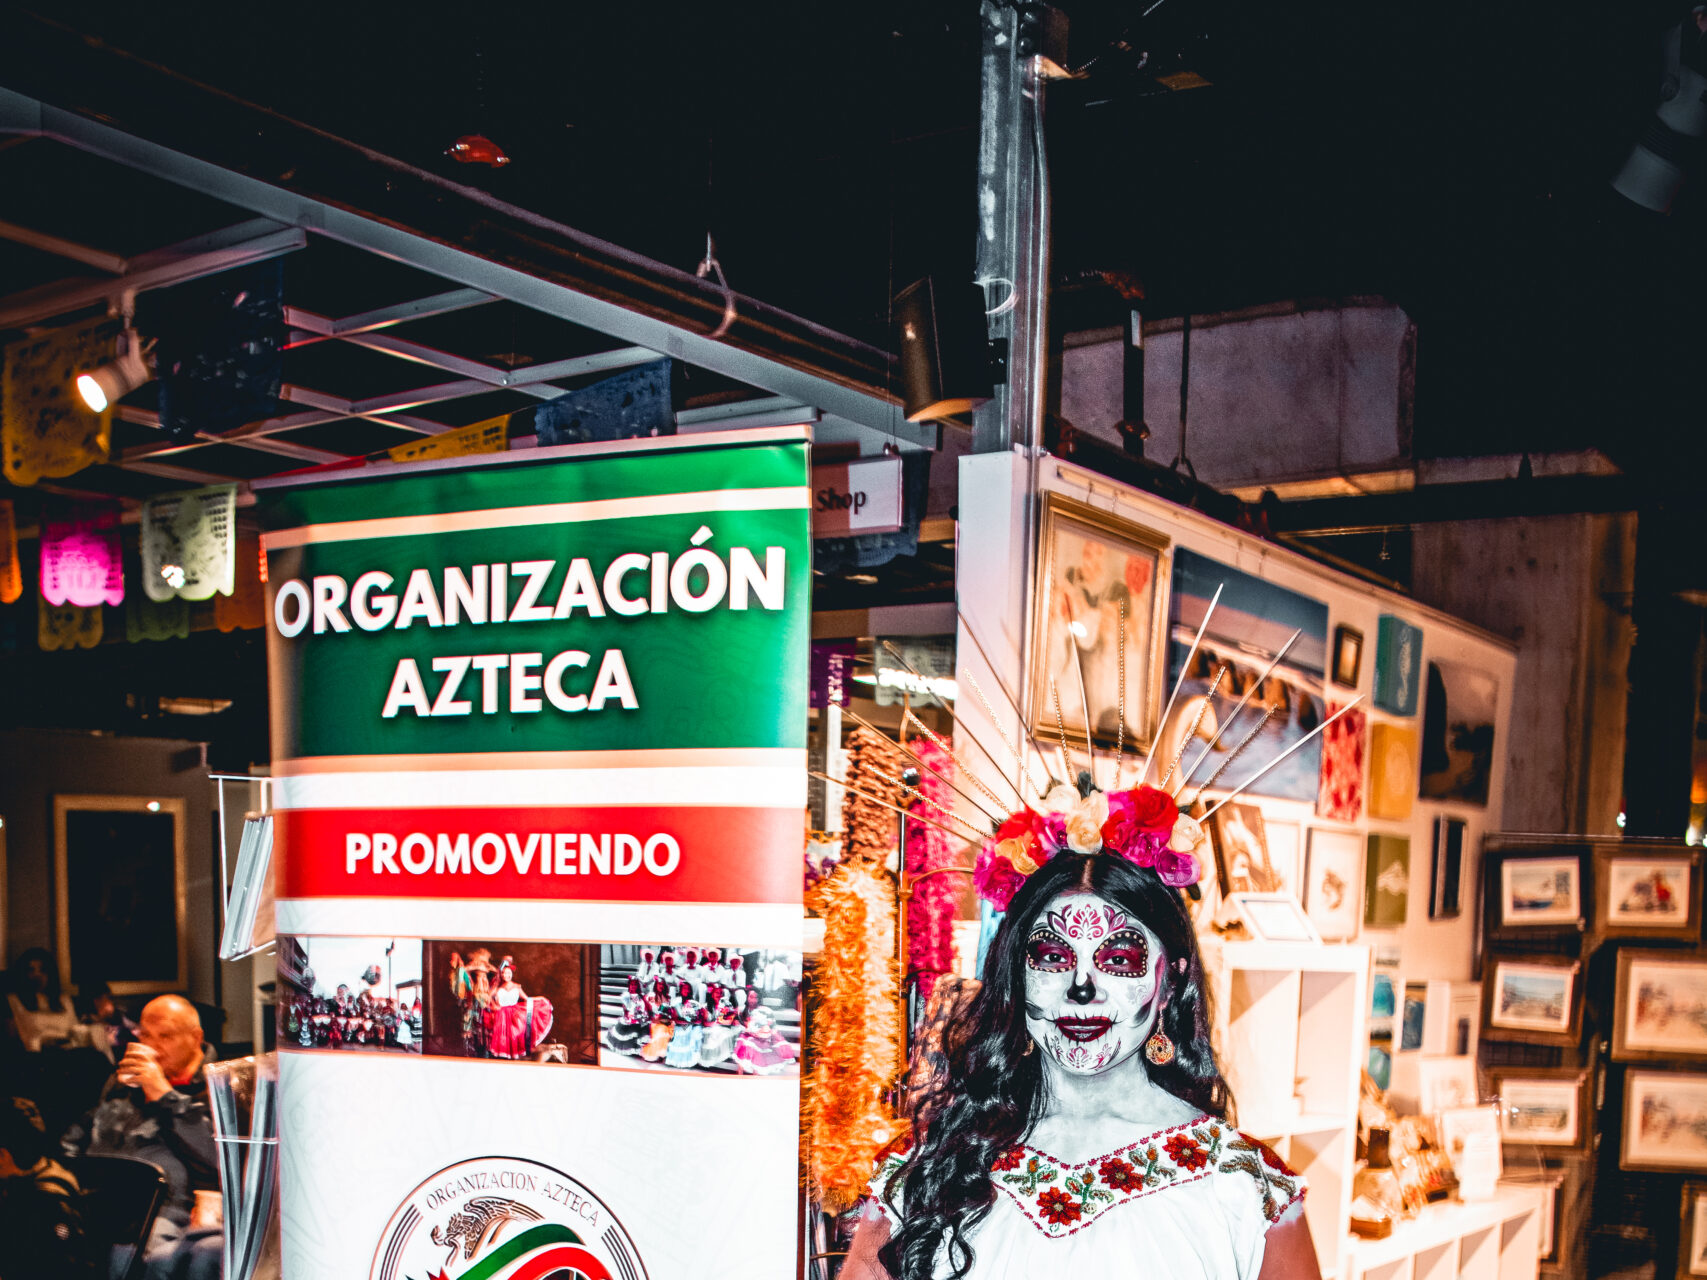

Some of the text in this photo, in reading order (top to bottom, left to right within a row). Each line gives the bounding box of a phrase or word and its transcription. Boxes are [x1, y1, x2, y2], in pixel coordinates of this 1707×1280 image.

[816, 487, 867, 515] Shop
[274, 525, 787, 638] ORGANIZACIÓN
[381, 648, 640, 719] AZTECA
[344, 831, 682, 877] PROMOVIENDO
[425, 1170, 601, 1228] ORGANIZACION AZTECA
